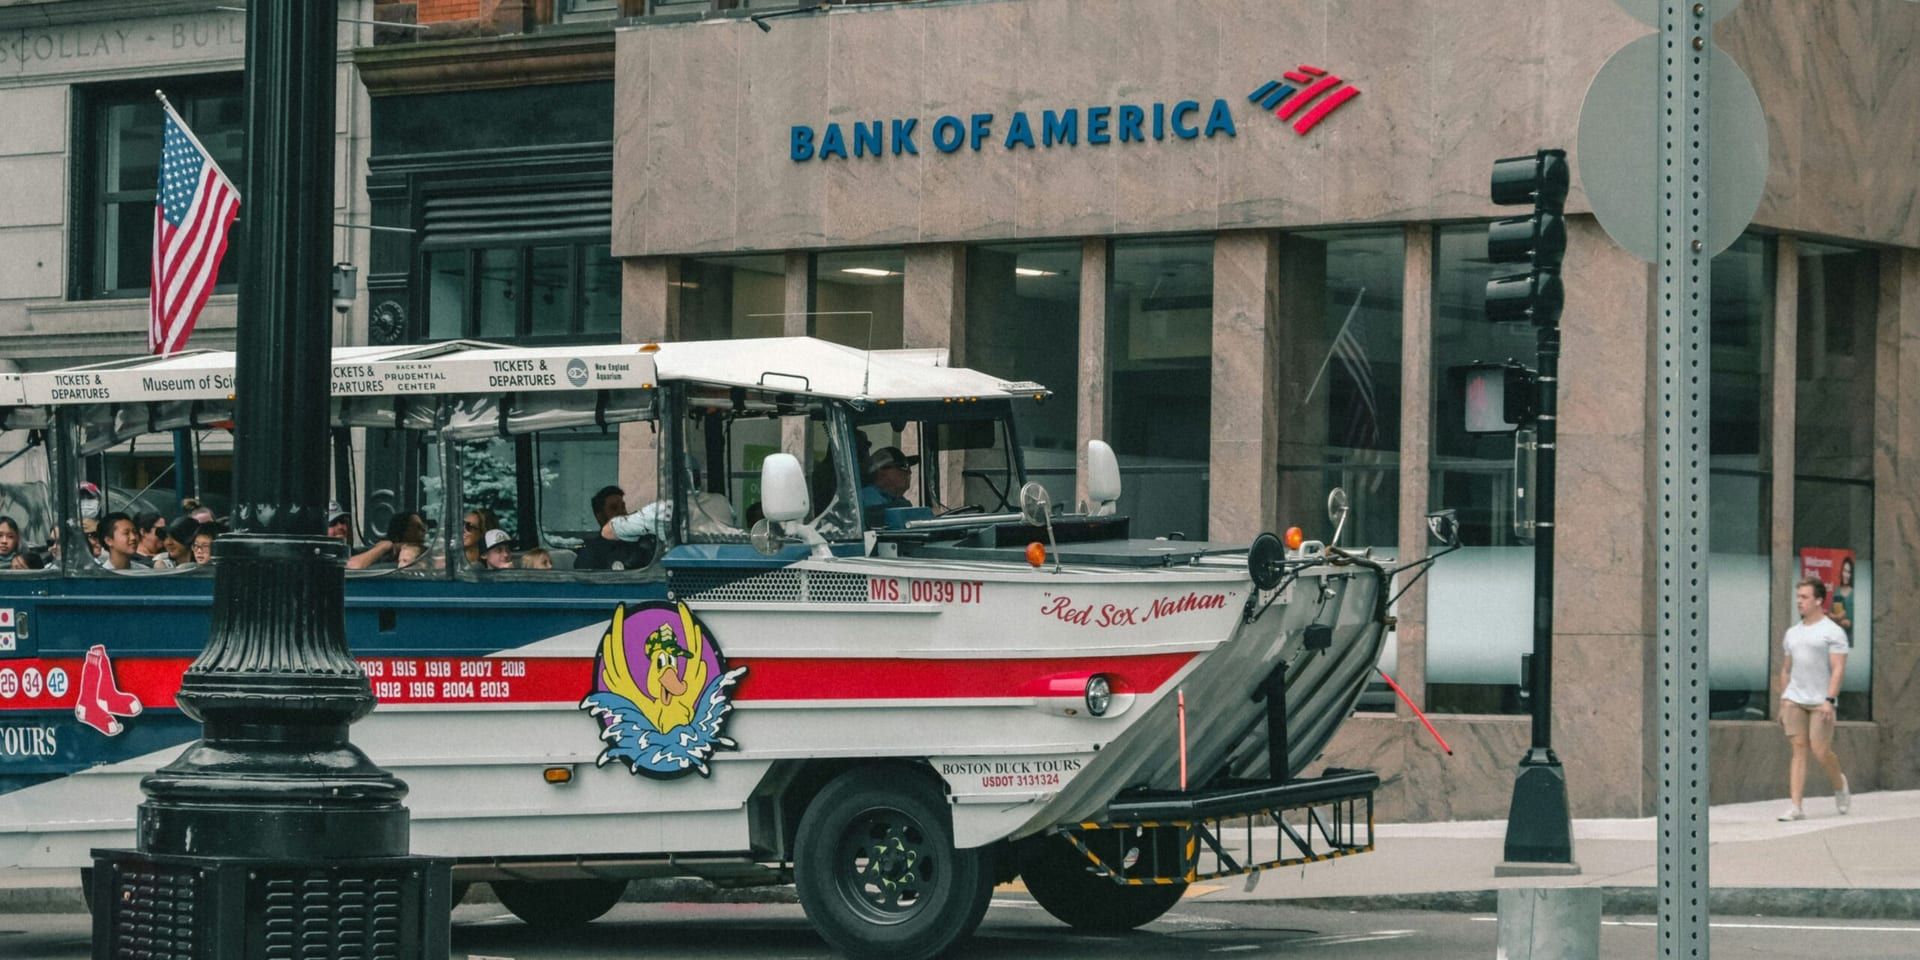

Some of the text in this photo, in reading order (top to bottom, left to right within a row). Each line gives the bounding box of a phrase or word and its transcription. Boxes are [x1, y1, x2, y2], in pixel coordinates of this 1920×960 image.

[172, 17, 244, 49] BUIL
[790, 98, 1236, 162] BANK OF AMERICA
[332, 365, 375, 378] CKETS &
[494, 360, 548, 372] TICKETS &
[595, 363, 630, 372] New England
[55, 374, 102, 386] TICKETS &
[142, 374, 235, 392] Museum of Sci
[384, 372, 447, 381] PRUDENTIAL
[489, 374, 557, 387] DEPARTURES
[596, 373, 622, 381] Aquarium
[332, 380, 385, 393] PARTURES
[397, 382, 436, 391] CENTER
[51, 388, 110, 400] DEPARTURES
[871, 578, 983, 604] MS 0039 DT
[1095, 603, 1138, 628] Sox
[391, 660, 417, 677] 1915
[424, 660, 451, 677] 1918
[460, 660, 493, 677] 2007
[501, 660, 526, 677] 2018
[0, 672, 65, 693] 26 34 42
[375, 681, 510, 698] 1912 1916 2004 2013
[942, 759, 1081, 775] BOSTON DUCK TOURS
[982, 773, 1060, 787] USDOT 3131324
